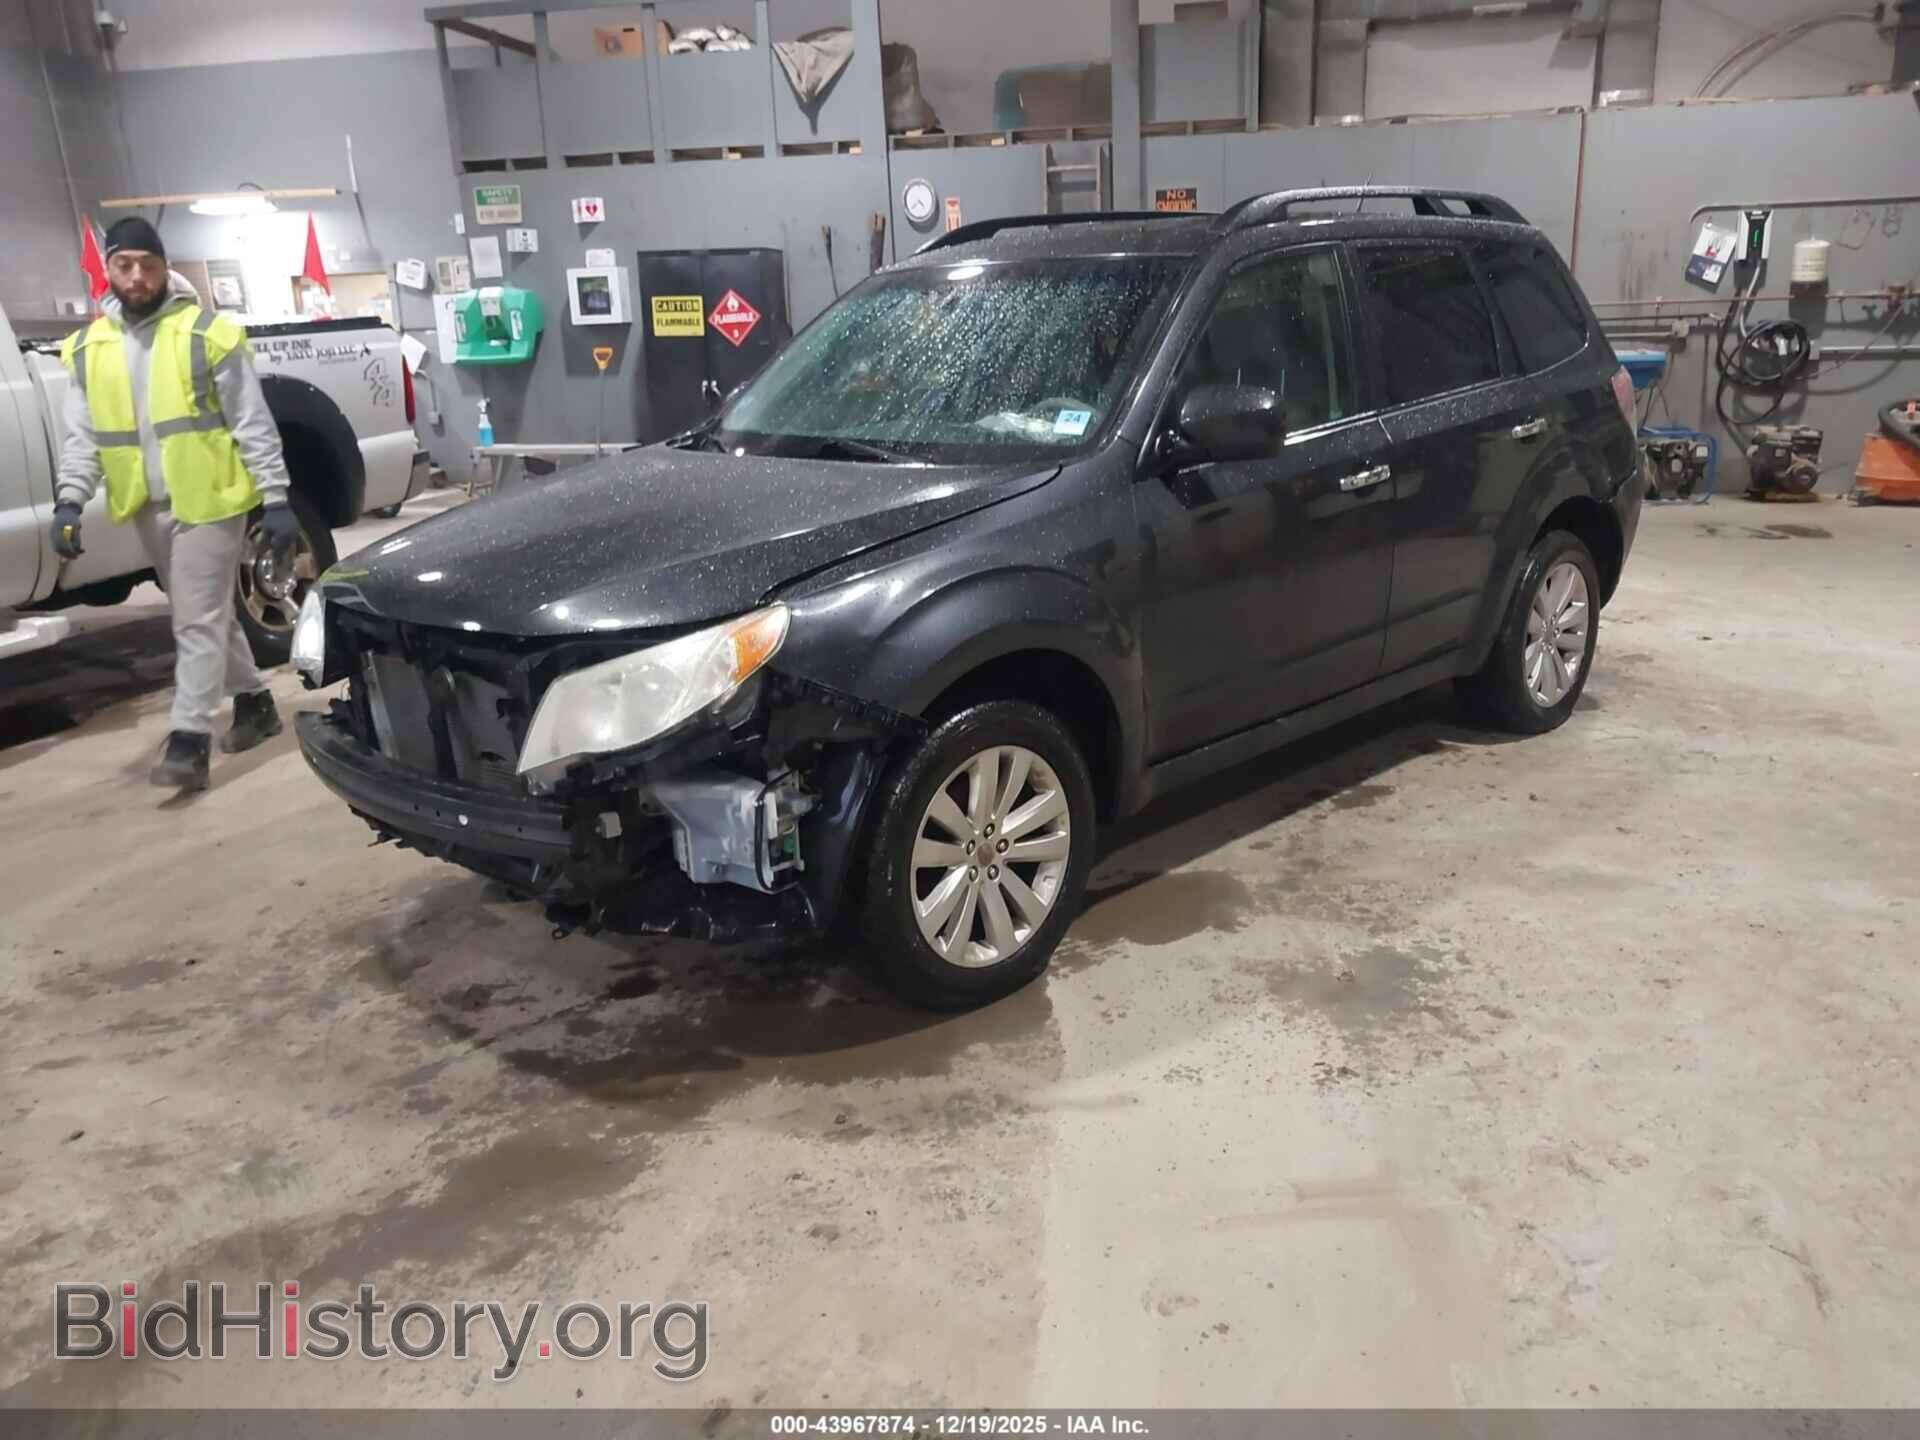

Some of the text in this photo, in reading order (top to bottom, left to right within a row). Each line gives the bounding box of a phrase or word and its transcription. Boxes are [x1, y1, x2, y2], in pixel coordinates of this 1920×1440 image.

[1167, 190, 1186, 200] NO
[655, 300, 700, 312] CAUTION
[656, 316, 701, 328] FLAMMABLE
[272, 341, 288, 351] UP
[291, 338, 312, 350] INK
[269, 351, 281, 366] by
